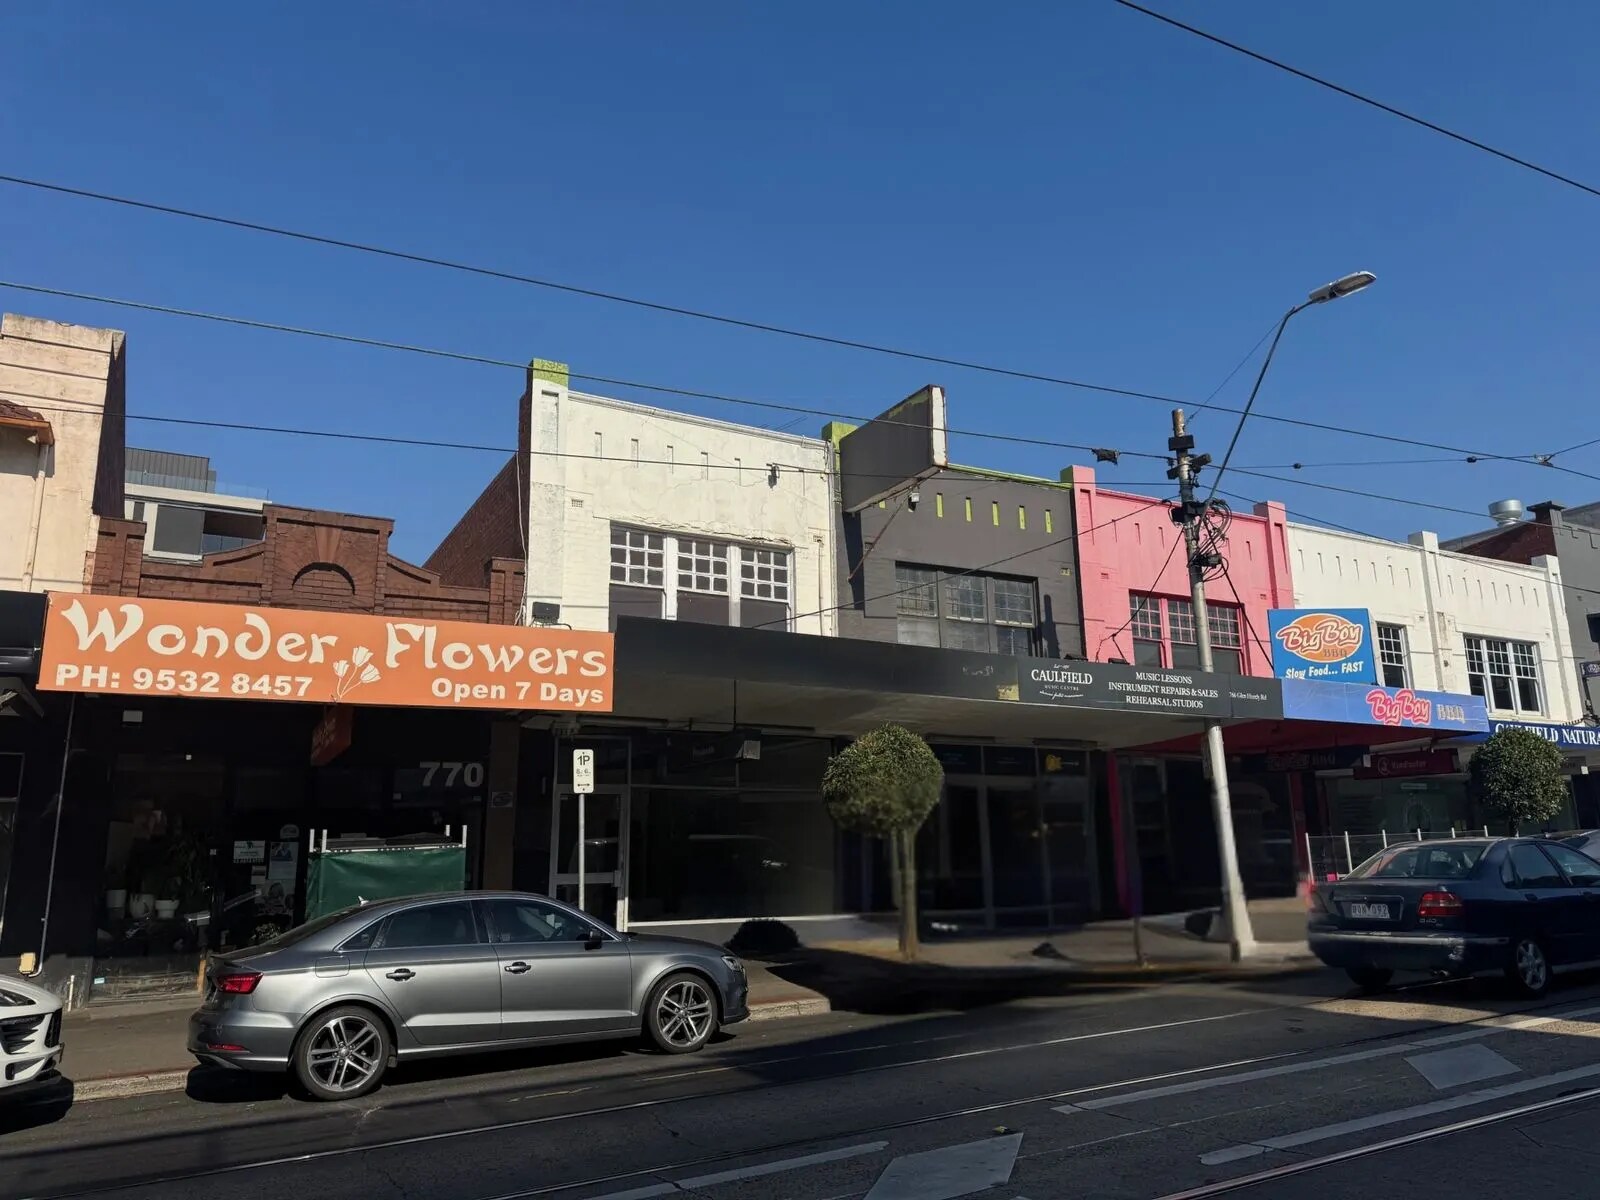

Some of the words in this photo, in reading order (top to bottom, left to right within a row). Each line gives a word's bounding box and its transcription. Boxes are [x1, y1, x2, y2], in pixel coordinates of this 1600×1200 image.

[61, 599, 338, 664] Wonder
[385, 622, 607, 678] Flowers
[1278, 625, 1322, 654] Big
[1315, 618, 1362, 646] Boy
[56, 664, 120, 689] PH:
[133, 668, 219, 694] 9532
[232, 672, 313, 698] 8457
[1031, 669, 1093, 685] CAULFIELD
[1135, 672, 1161, 682] MUSIC
[1161, 674, 1193, 685] LESSONS
[1285, 667, 1306, 679] Slow
[1308, 664, 1338, 677] Food...
[1341, 661, 1364, 674] FAST
[431, 677, 506, 703] Open
[516, 683, 533, 701] 7
[540, 683, 604, 706] Days
[1108, 682, 1160, 694] INSTRUMENT
[1161, 686, 1191, 696] REPAIRS
[1191, 688, 1198, 697] &
[1198, 689, 1219, 698] SALES
[1126, 695, 1172, 707] REHEARSAL
[1172, 698, 1204, 709] STUDIOS
[1367, 690, 1402, 724] Big
[1395, 688, 1431, 724] Boy
[577, 755, 590, 766] 1P
[420, 761, 484, 788] 770
